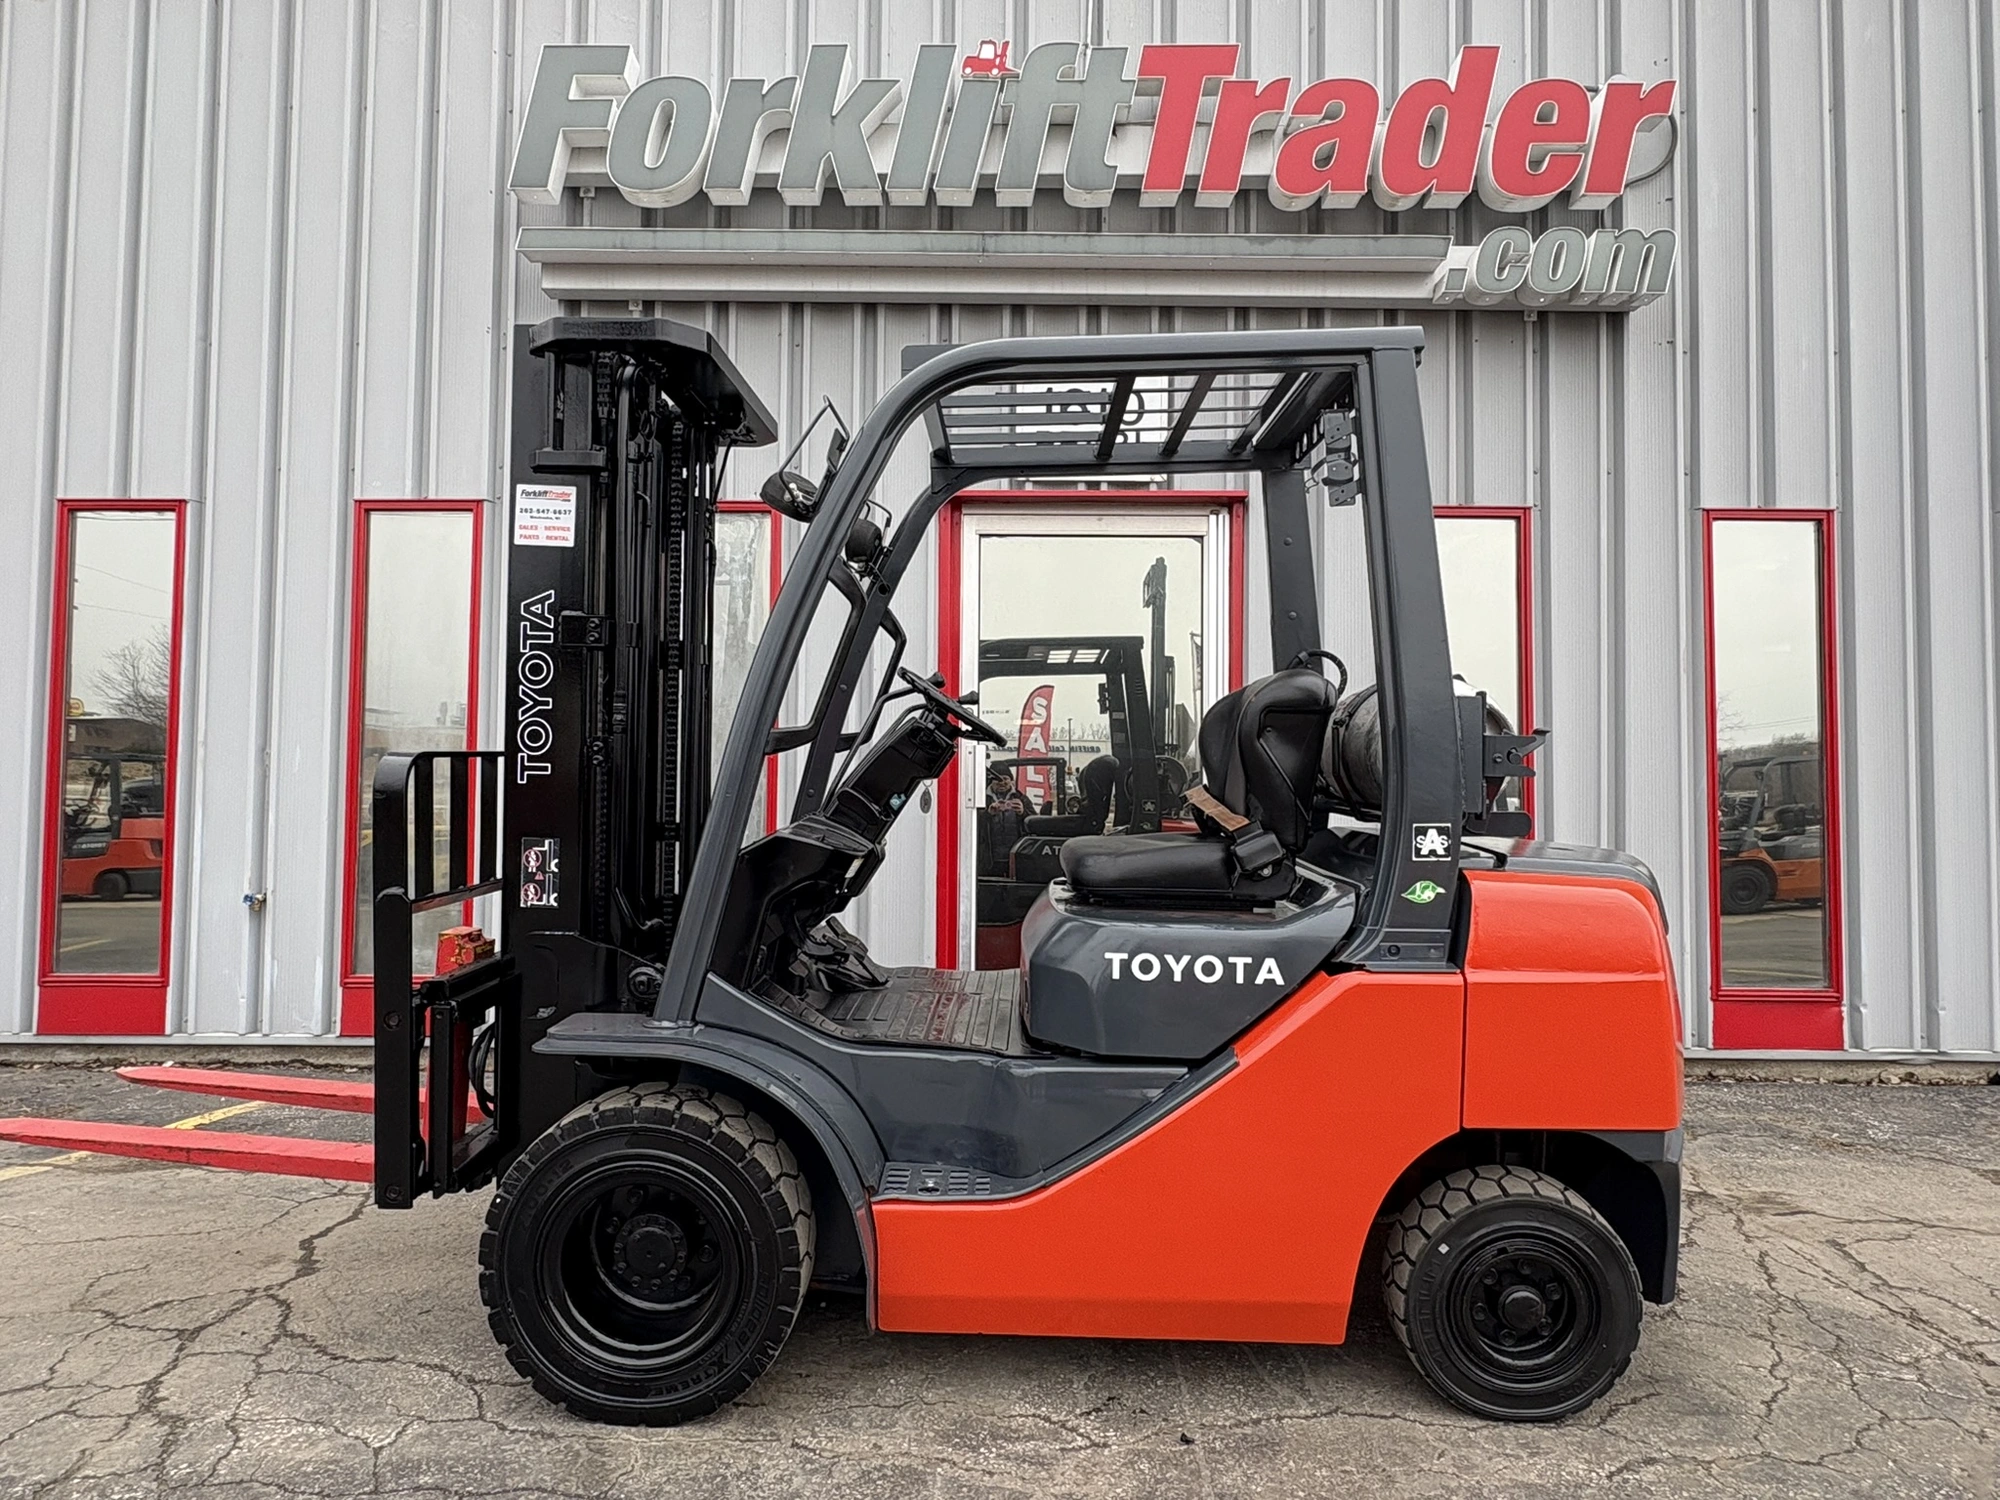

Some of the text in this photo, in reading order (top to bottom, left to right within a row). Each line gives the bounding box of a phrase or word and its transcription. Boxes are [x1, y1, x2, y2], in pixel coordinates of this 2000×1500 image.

[1440, 226, 1677, 303] .com
[517, 589, 555, 784] TOYOTA
[1104, 951, 1286, 986] TOYOTA
